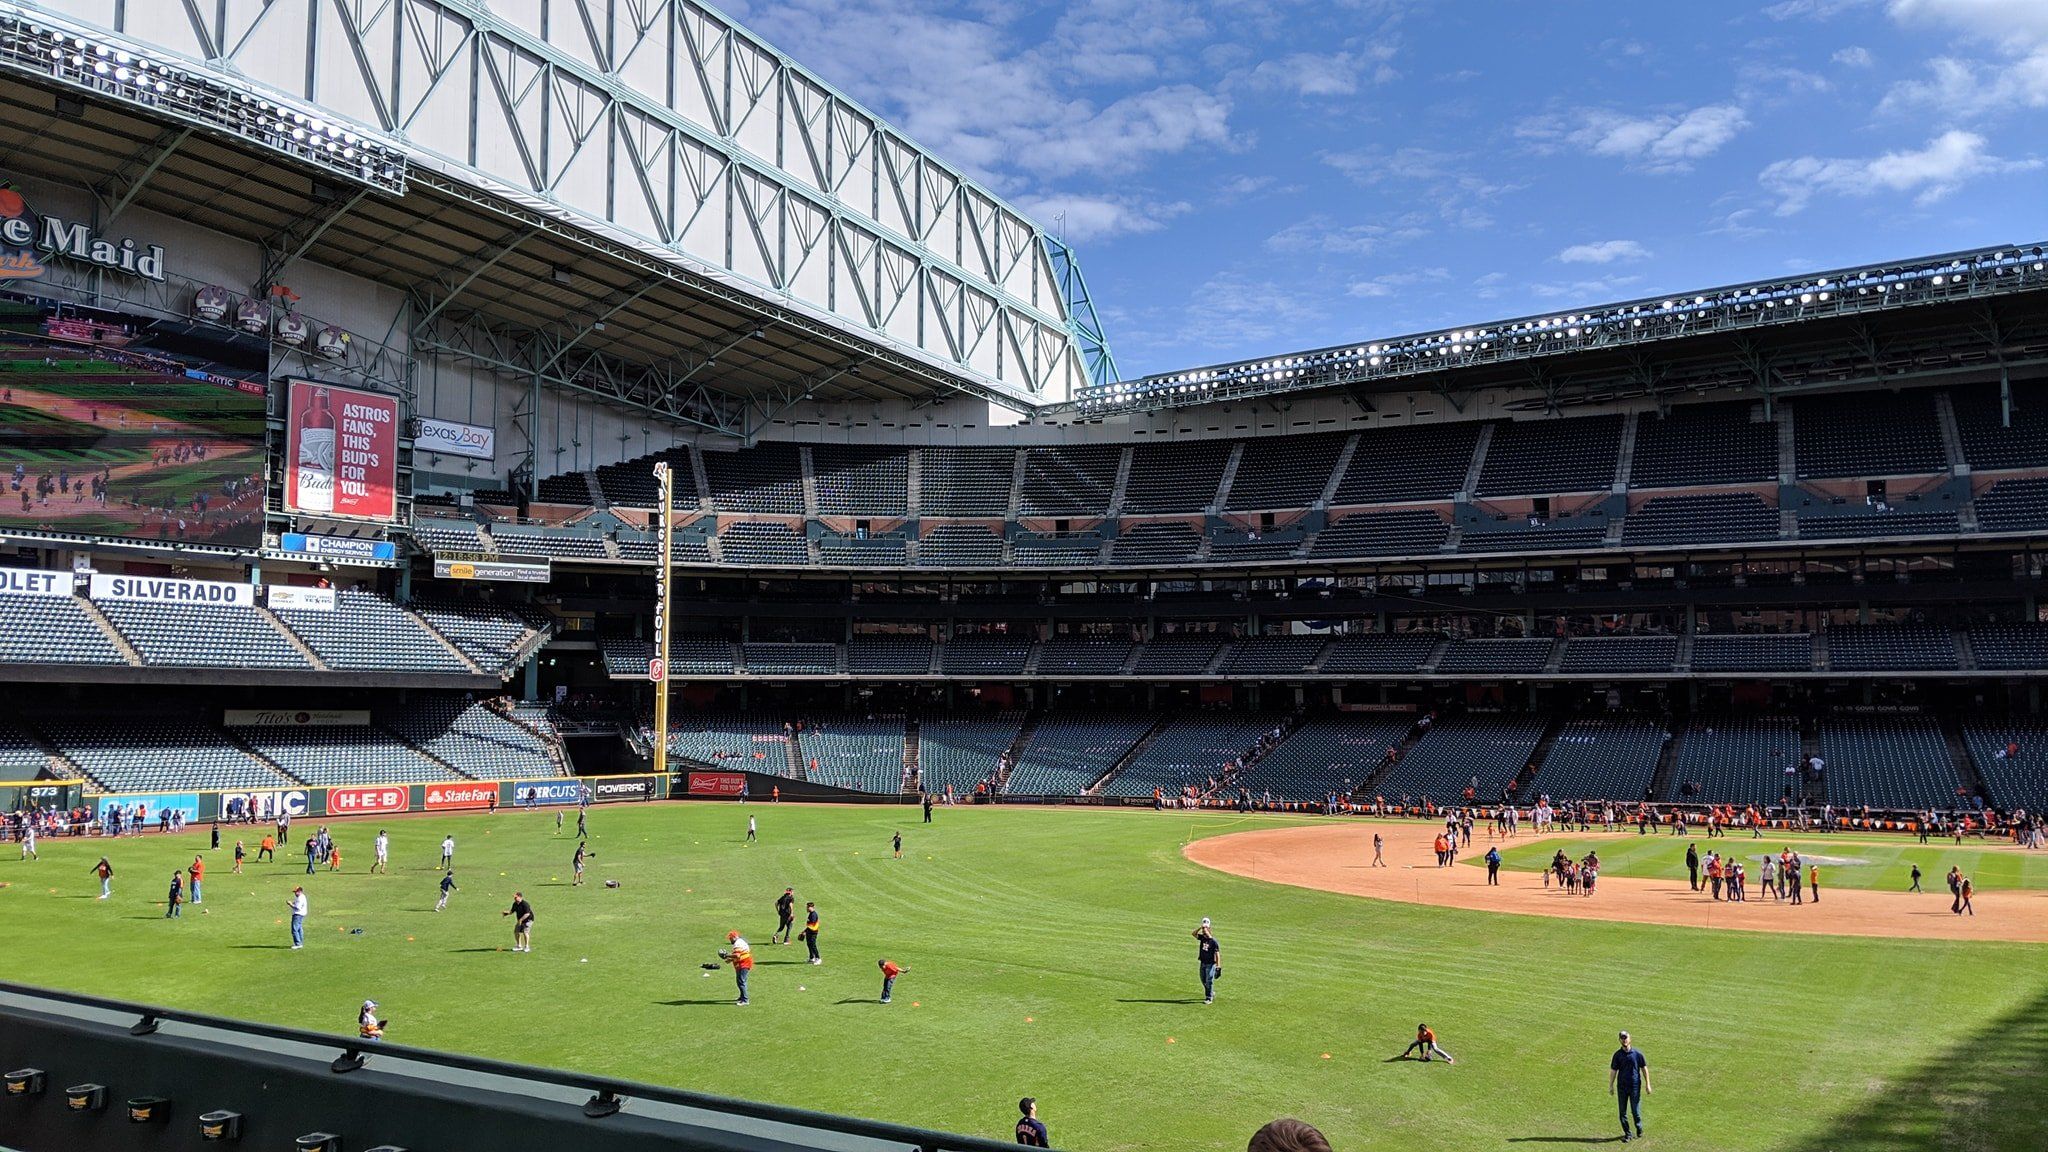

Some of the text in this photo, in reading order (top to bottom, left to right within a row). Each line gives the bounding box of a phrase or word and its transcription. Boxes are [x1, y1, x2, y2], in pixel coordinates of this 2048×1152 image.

[42, 216, 165, 282] Maid
[343, 403, 390, 423] ASTROS
[343, 419, 377, 438] FANS,
[342, 434, 370, 451] THIS
[423, 425, 489, 449] exas Bay
[342, 450, 379, 467] BUD'S
[341, 466, 366, 481] FOR
[340, 480, 369, 496] YOU.
[320, 538, 373, 551] CHAMPION
[482, 554, 499, 562] PM
[437, 565, 450, 574] the
[474, 569, 514, 577] generation
[112, 578, 237, 602] SILVERADO
[255, 712, 291, 724] Tito's
[31, 788, 57, 797] 373
[597, 783, 654, 794] POWERAD
[222, 791, 306, 819] RTIC
[340, 793, 398, 808] H-E-B
